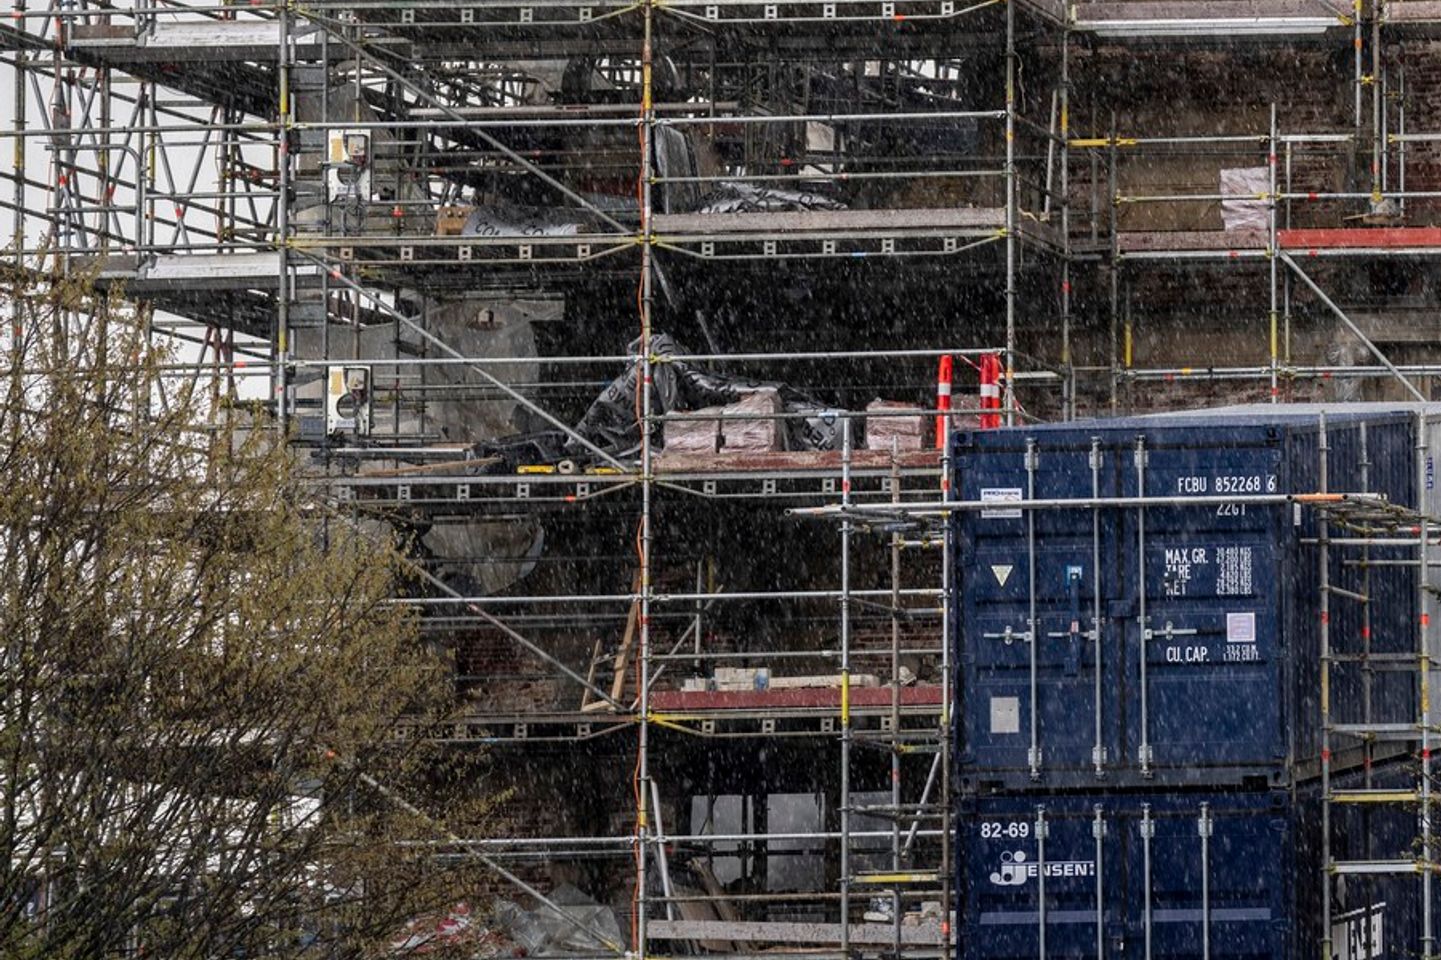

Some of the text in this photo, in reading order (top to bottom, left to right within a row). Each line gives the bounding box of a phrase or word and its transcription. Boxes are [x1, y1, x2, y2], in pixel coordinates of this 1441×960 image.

[1178, 477, 1207, 492] FCBU
[1215, 476, 1260, 492] 852268
[981, 822, 1029, 838] 82-69
